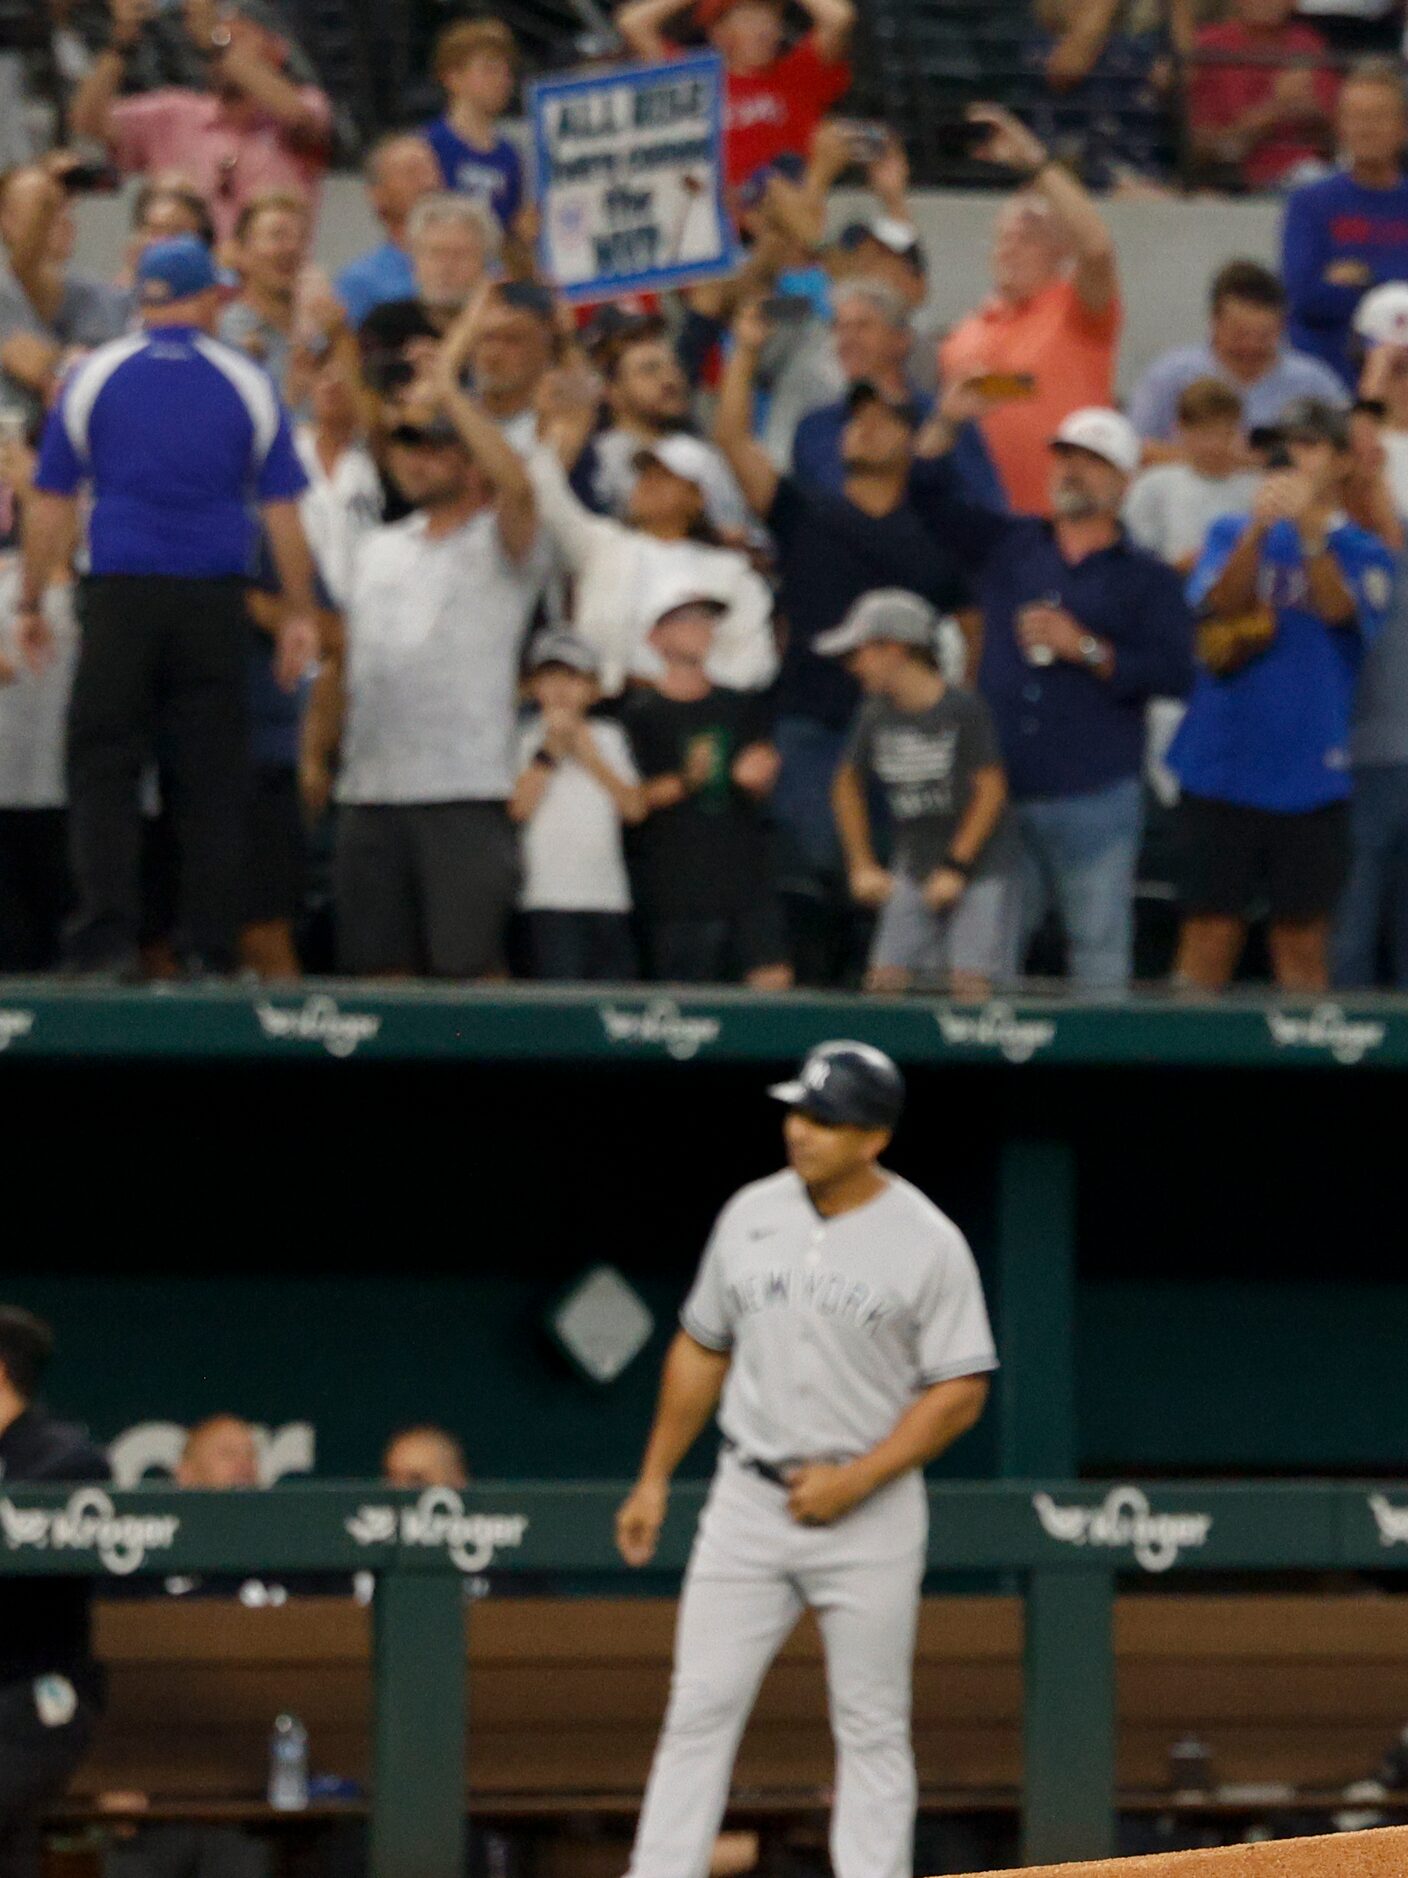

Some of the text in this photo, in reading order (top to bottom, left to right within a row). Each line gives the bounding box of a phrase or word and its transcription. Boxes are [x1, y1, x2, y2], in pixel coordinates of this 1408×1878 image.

[51, 1487, 180, 1575] Kroger
[401, 1486, 529, 1572] Kroger
[1088, 1486, 1212, 1572] Kroger
